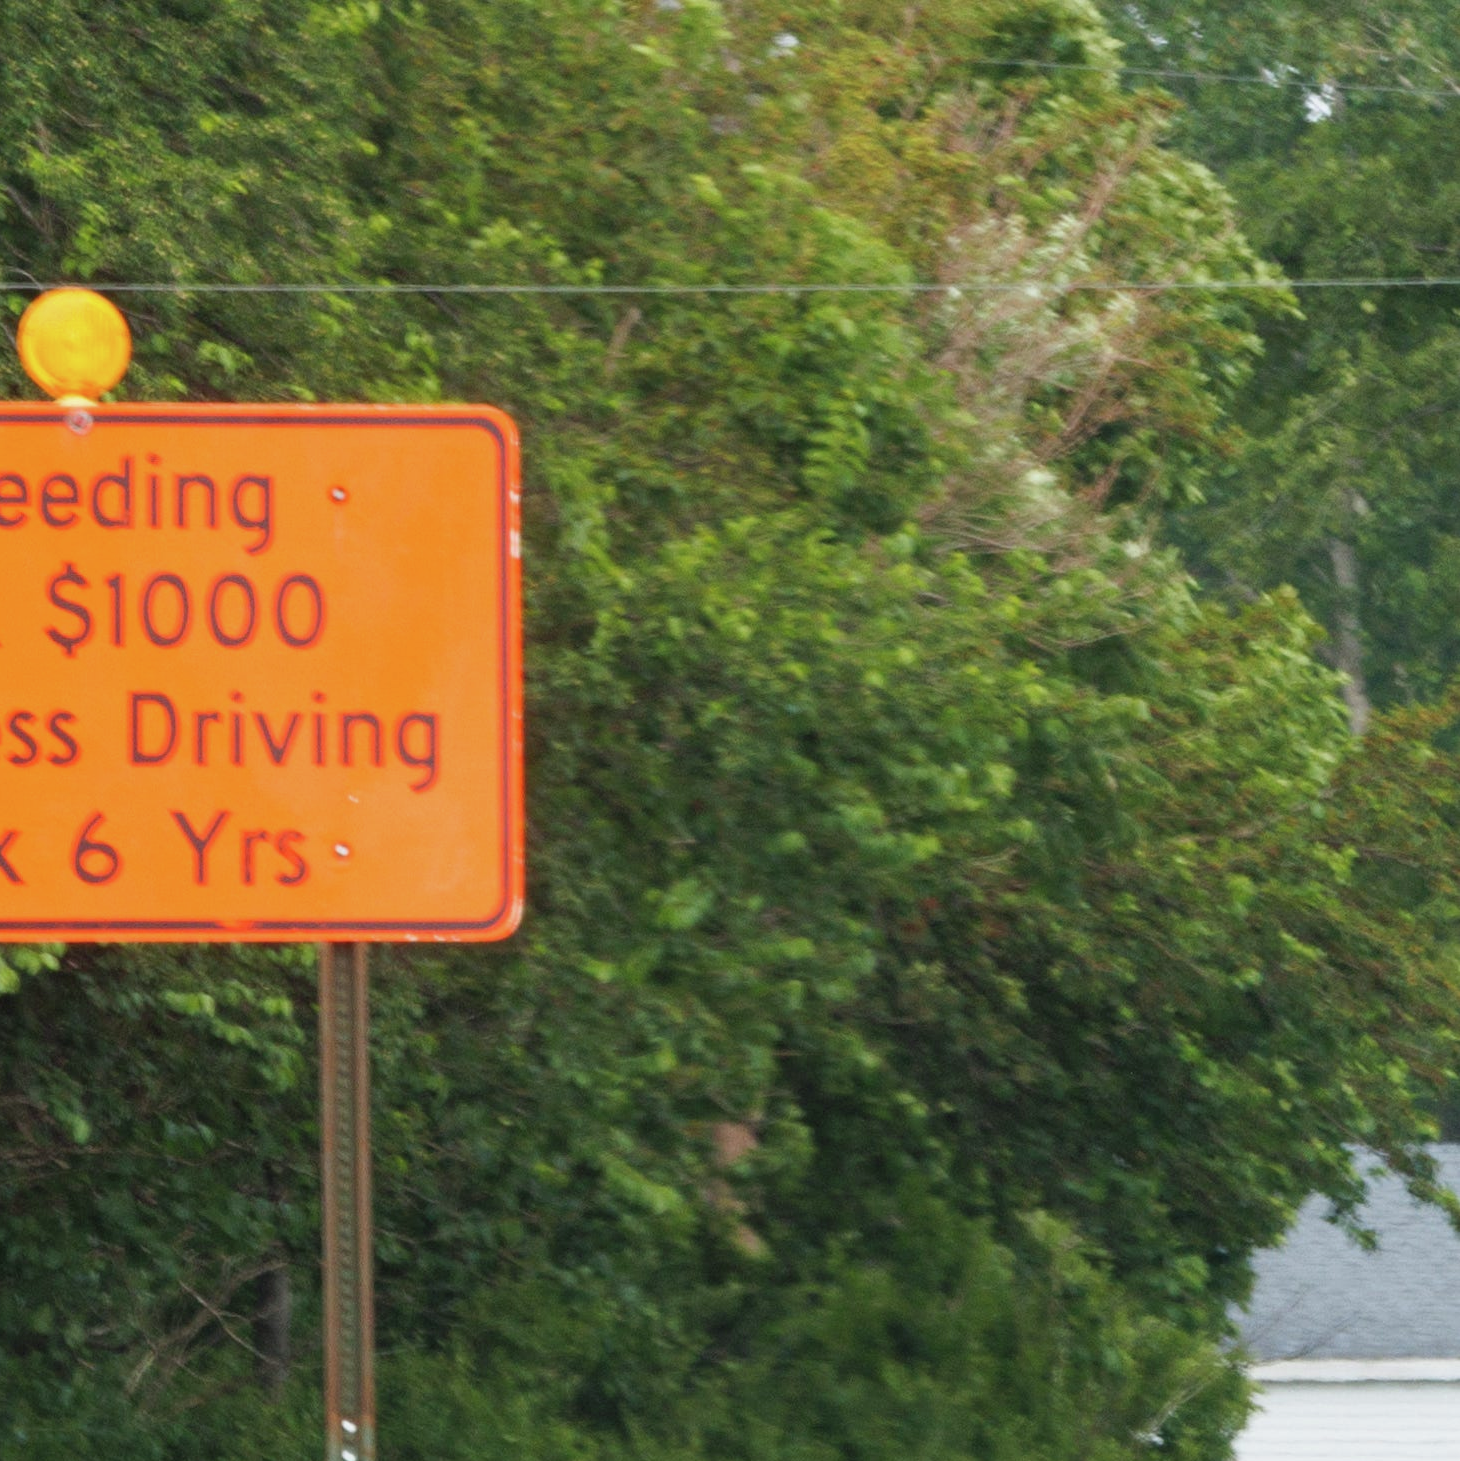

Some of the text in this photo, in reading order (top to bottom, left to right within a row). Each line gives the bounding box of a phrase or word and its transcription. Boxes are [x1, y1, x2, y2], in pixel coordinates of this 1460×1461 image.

[46, 563, 324, 656] $1000
[130, 692, 438, 791] Driving
[72, 814, 120, 885] 6
[173, 811, 309, 885] Yrs
